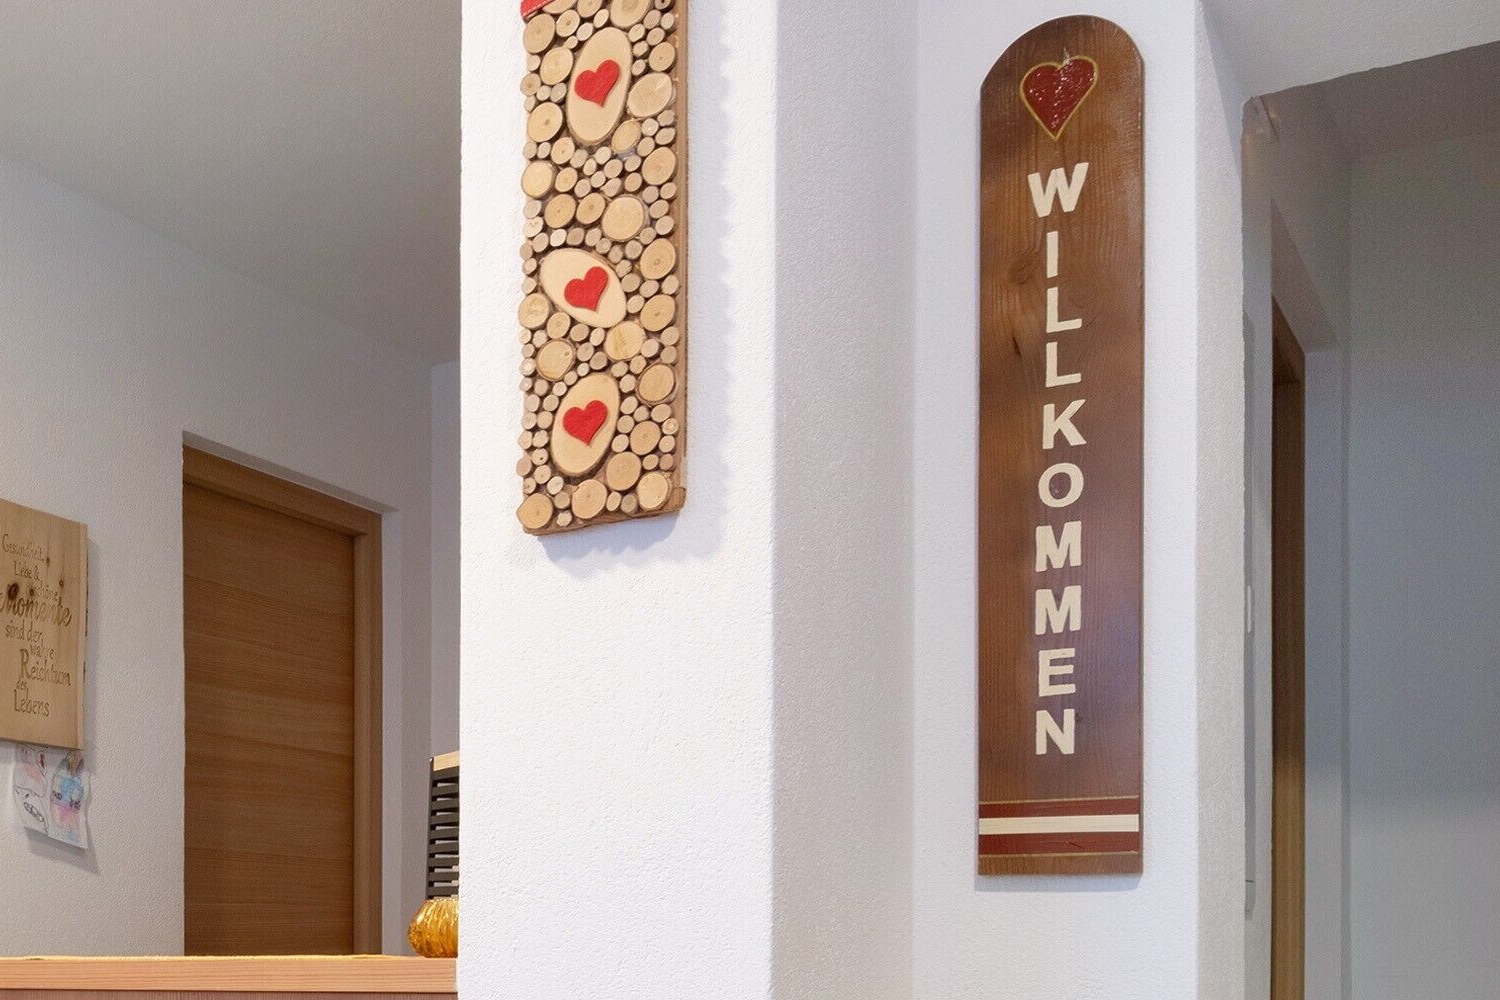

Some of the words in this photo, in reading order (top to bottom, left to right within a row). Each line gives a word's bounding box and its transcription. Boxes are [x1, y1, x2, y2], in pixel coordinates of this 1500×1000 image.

[1027, 162, 1090, 756] WILLKOMMEN
[5, 619, 25, 641] sind
[20, 648, 71, 687] Reichtum
[13, 688, 50, 717] Lebens
